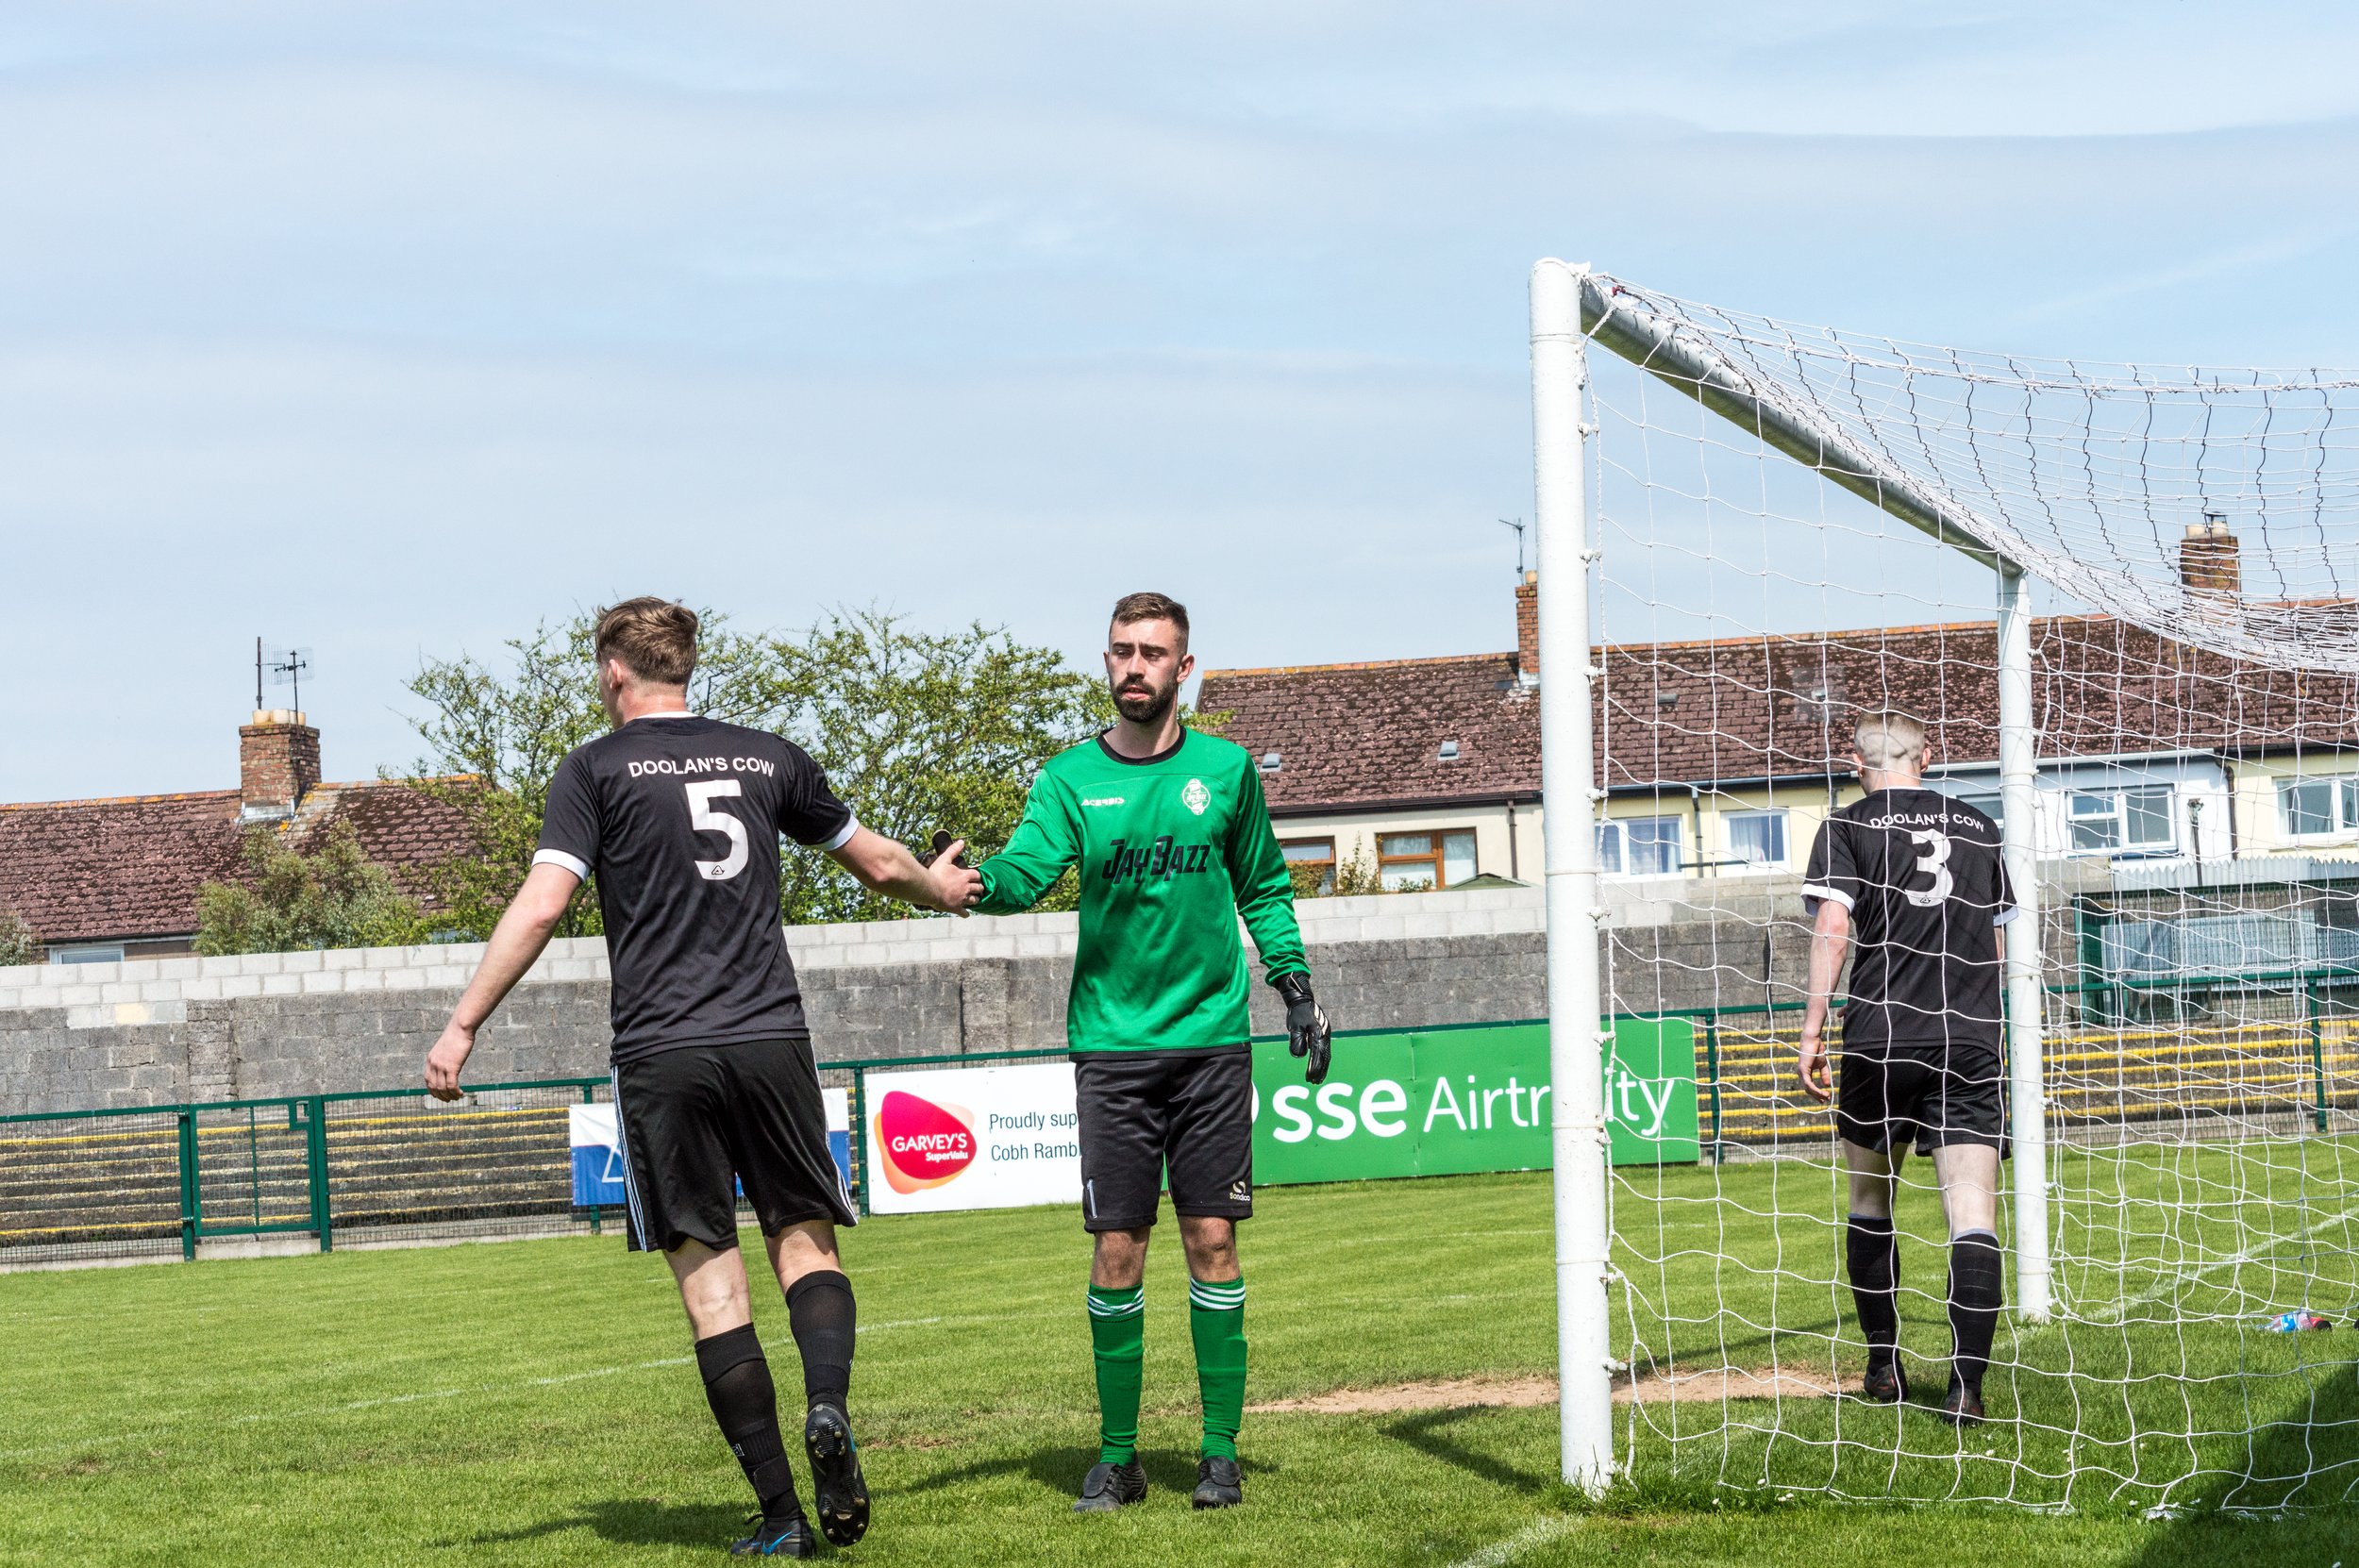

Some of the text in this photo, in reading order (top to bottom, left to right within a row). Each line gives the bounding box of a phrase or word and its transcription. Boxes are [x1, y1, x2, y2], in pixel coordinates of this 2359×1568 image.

[627, 757, 775, 778] DOOLAN'S COW
[684, 779, 749, 880] 5
[1869, 813, 1984, 832] DOOLAN'S COW
[1904, 827, 1954, 908] 3
[1272, 1071, 1675, 1143] sse Airtrity
[989, 1111, 1079, 1130] Proudly sup
[892, 1132, 968, 1152] GARVEY'S
[991, 1143, 1029, 1161] Cobh
[925, 1150, 969, 1163] SuperValu
